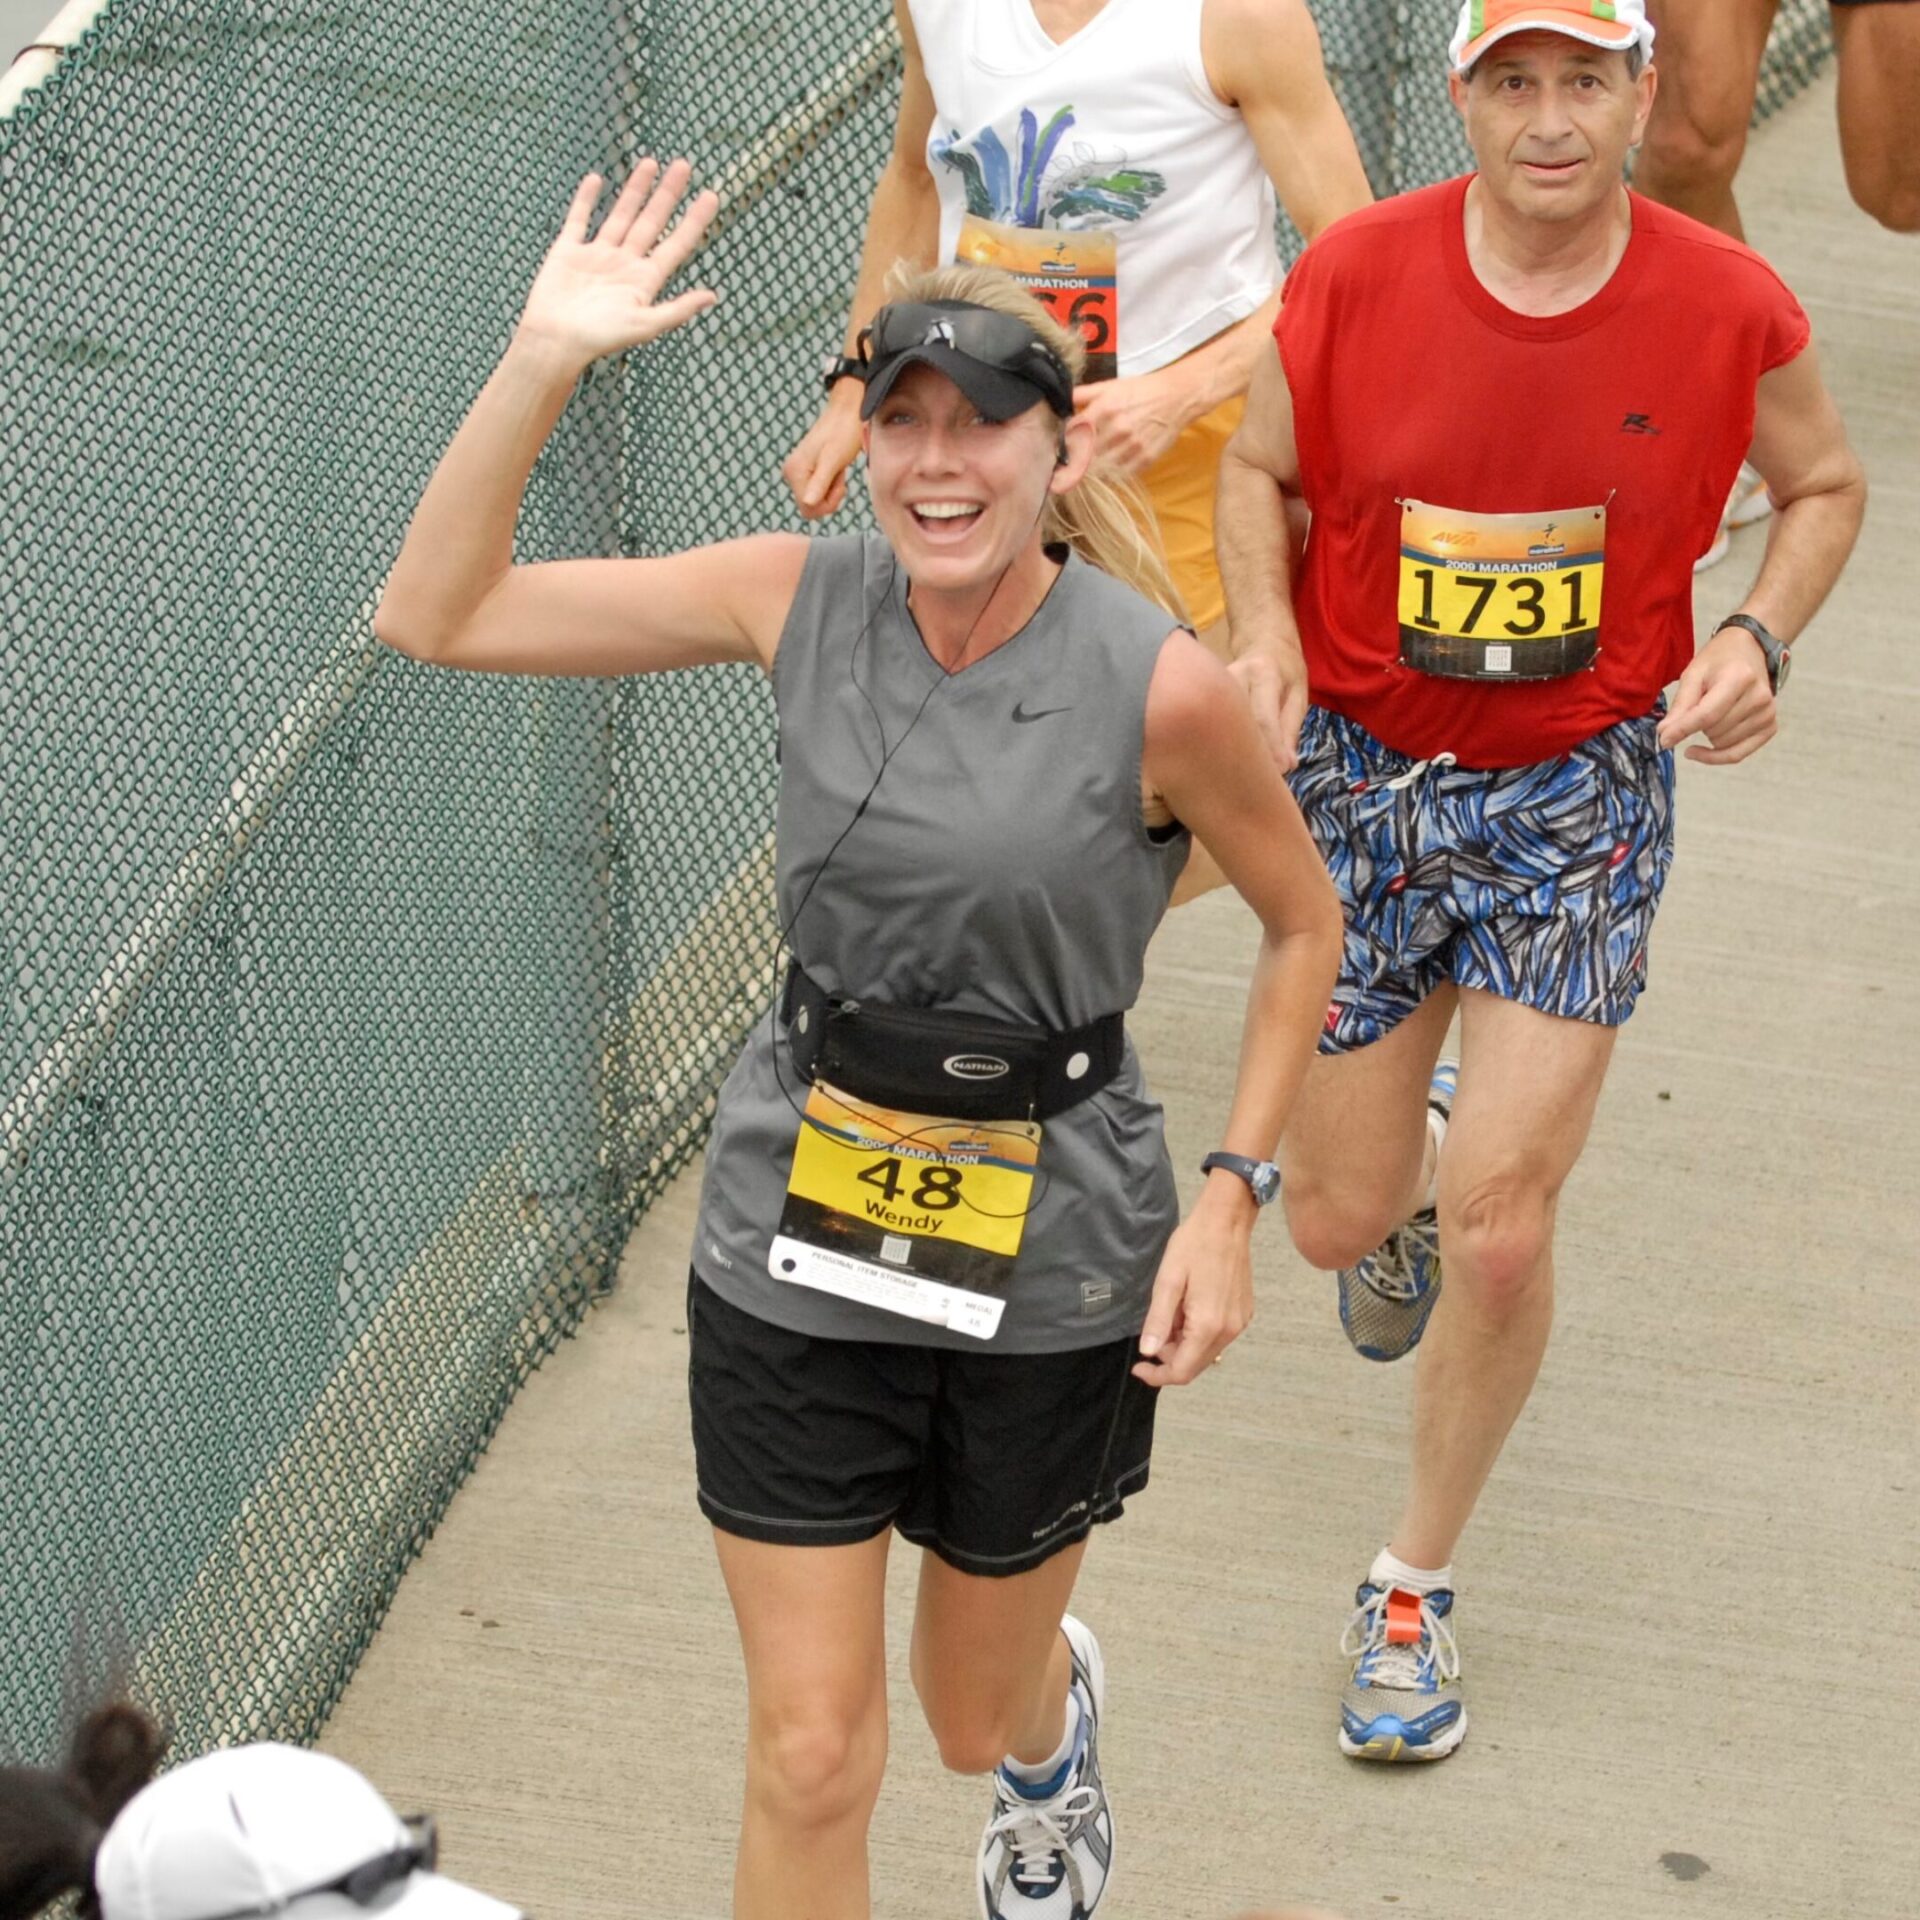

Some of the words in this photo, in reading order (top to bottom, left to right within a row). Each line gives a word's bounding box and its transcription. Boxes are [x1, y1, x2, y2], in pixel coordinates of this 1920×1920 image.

[1446, 559, 1476, 572] 2009
[1479, 560, 1558, 574] MARATHON
[1414, 568, 1587, 636] 1731
[953, 1061, 1004, 1072] NATHAN
[857, 1157, 963, 1210] 48
[865, 1198, 943, 1234] Wendy
[811, 1251, 855, 1271] PERSONAL
[857, 1264, 879, 1278] ITEM
[879, 1267, 918, 1289] STORAGE
